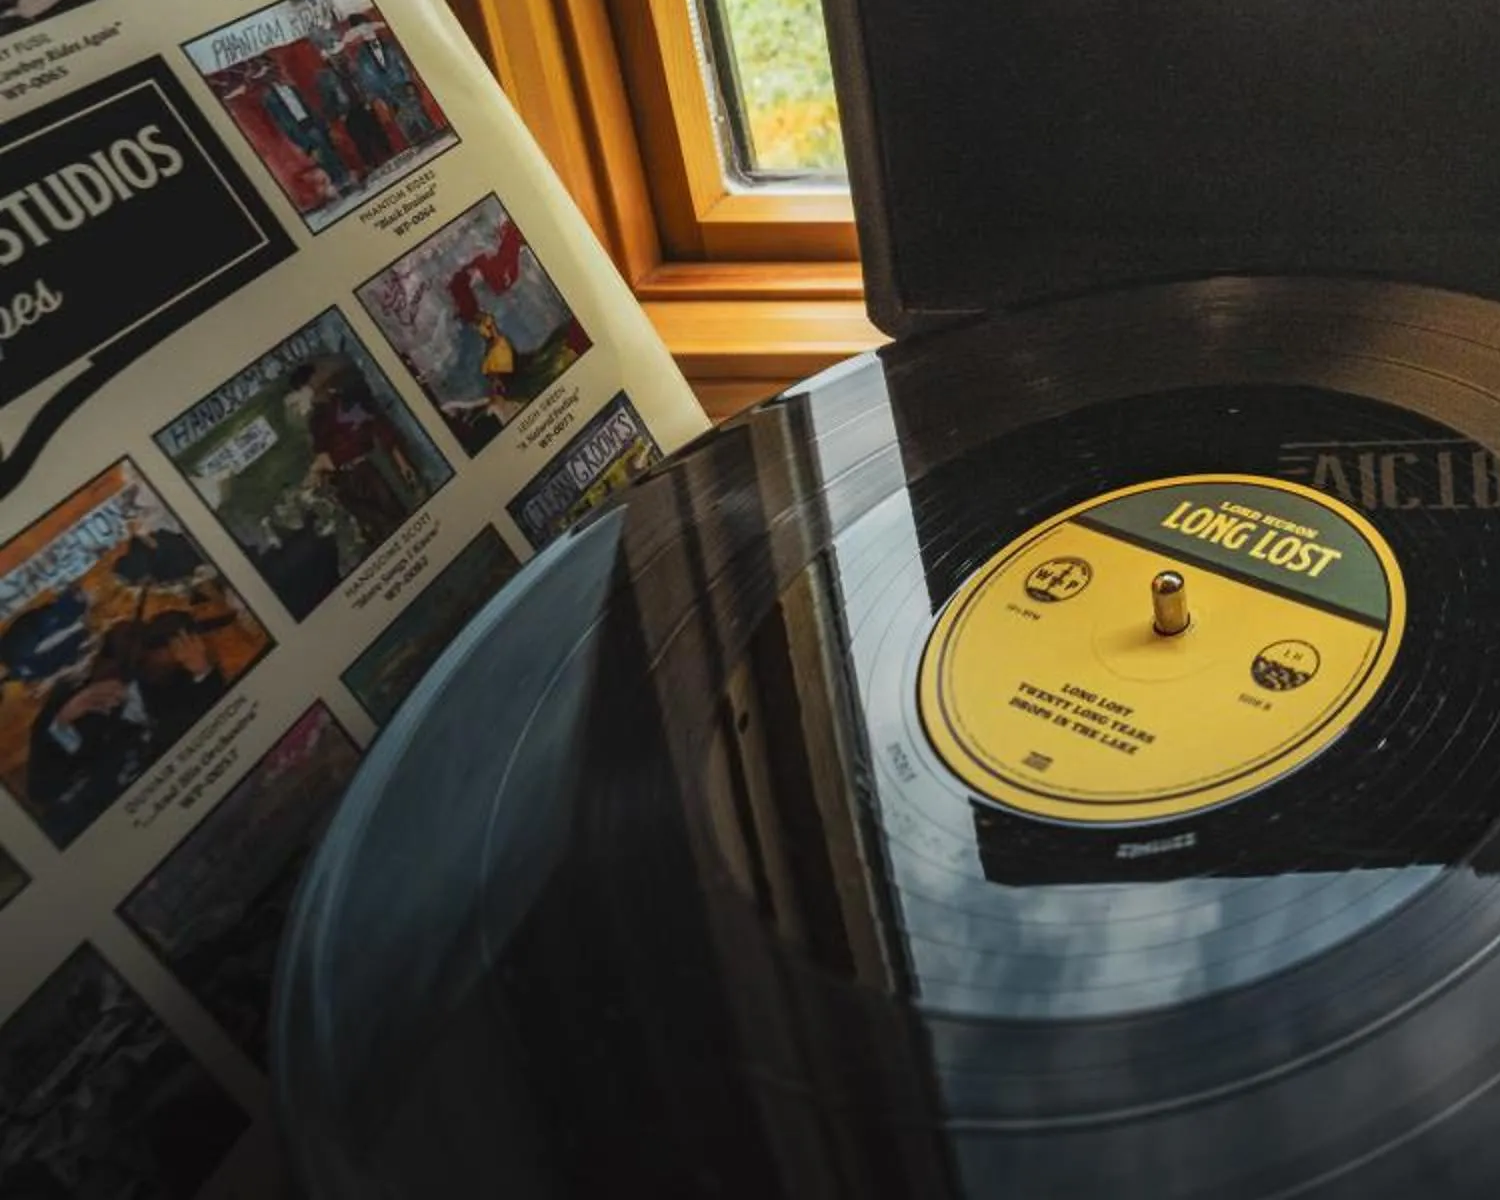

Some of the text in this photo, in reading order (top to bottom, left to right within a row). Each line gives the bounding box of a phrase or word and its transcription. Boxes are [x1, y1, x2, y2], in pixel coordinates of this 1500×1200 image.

[1160, 500, 1343, 578] LONG LOST
[1219, 501, 1263, 521] LORD
[1008, 696, 1140, 756] DROPS IN THE LAKE
[1018, 681, 1156, 744] TWENTY LONG YEARS
[1061, 683, 1134, 717] LONG LOST
